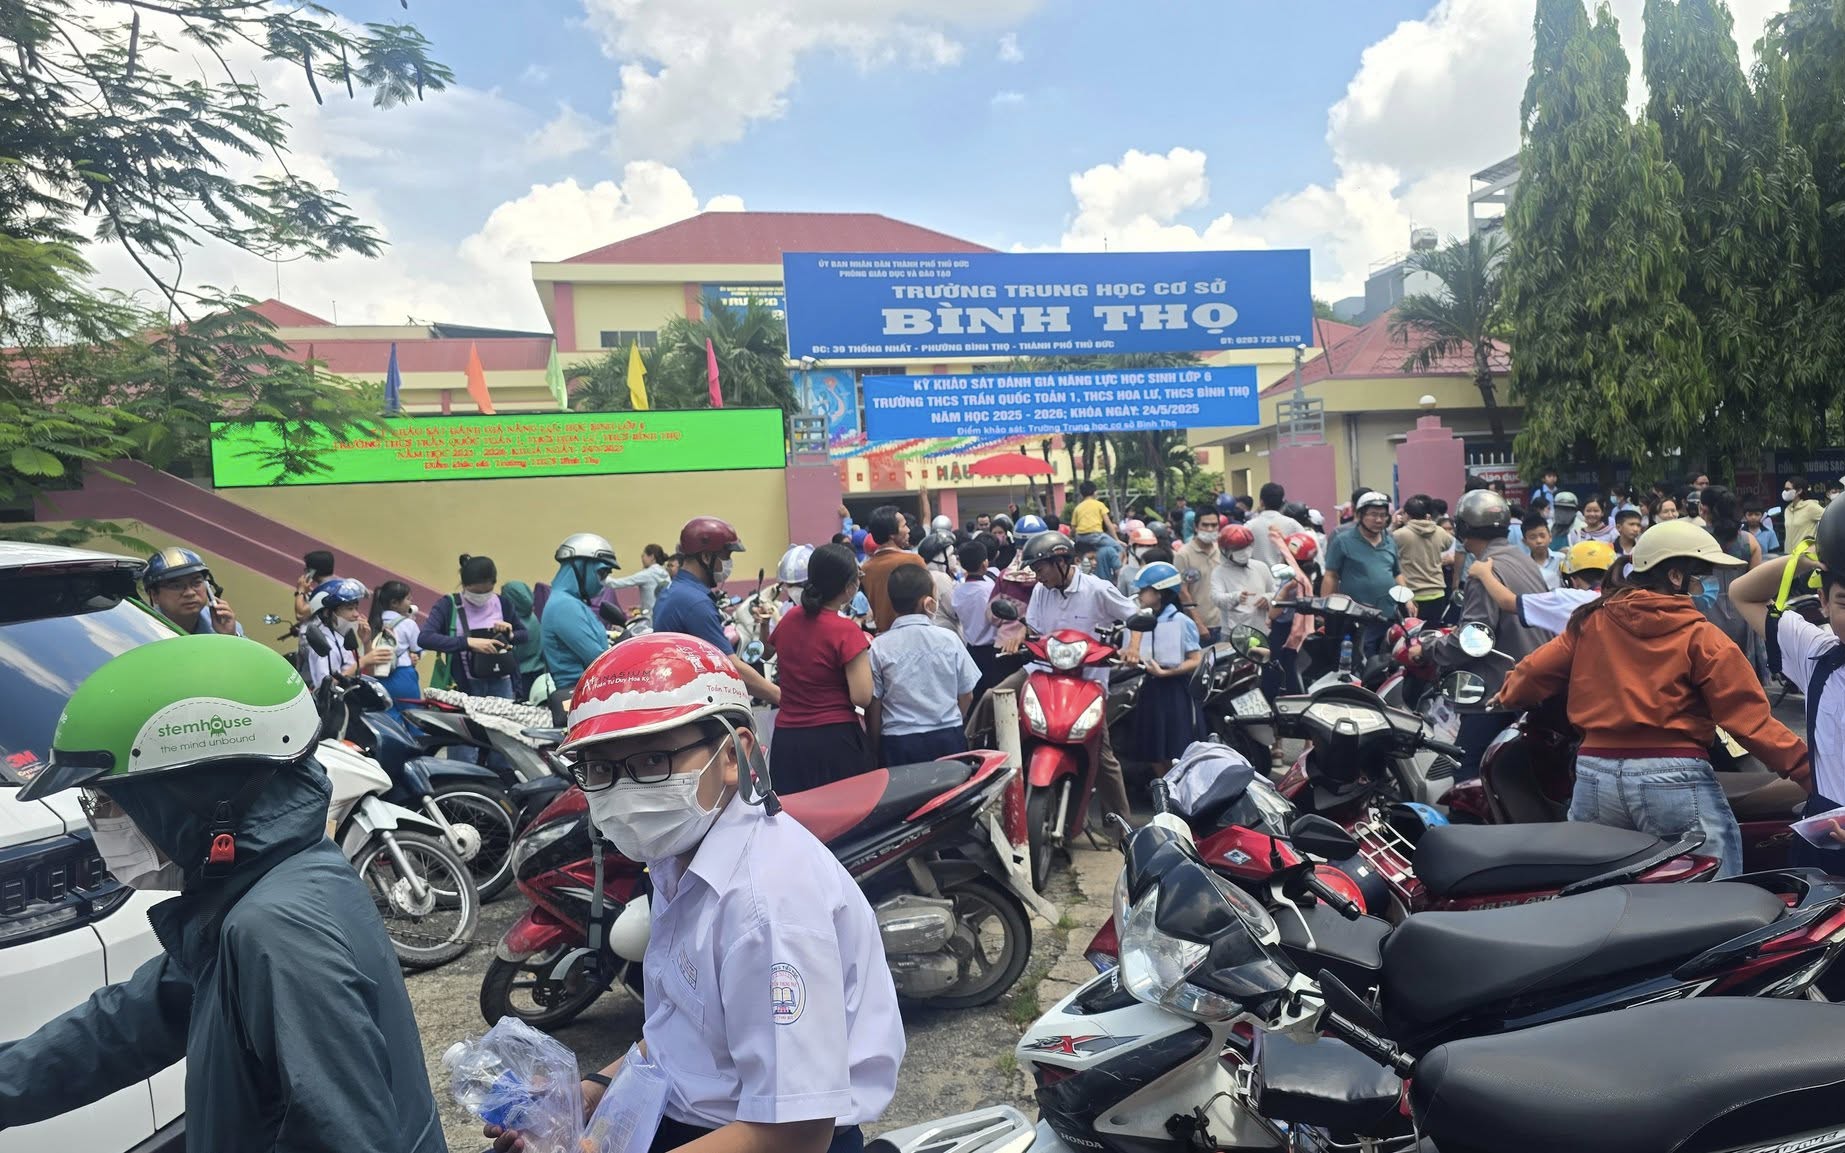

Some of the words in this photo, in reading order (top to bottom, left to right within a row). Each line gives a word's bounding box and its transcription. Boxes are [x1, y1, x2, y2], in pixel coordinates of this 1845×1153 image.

[831, 260, 848, 268] BAN
[891, 283, 997, 299] TRƯỜNG
[1004, 284, 1088, 298] TRUNG
[1096, 283, 1146, 298] HỌC
[1154, 281, 1187, 296] CƠ
[1194, 278, 1227, 294] SỞ
[881, 302, 1071, 335] BÌNH
[1093, 302, 1238, 334] THỌ
[848, 343, 883, 353] THỐNG
[884, 343, 912, 352] NHẤT
[921, 343, 963, 352] PHƯỜNG
[964, 342, 989, 351] BÌNH
[991, 343, 1010, 352] THỌ
[1018, 341, 1051, 350] THÀNH
[1053, 340, 1072, 349] PHỐ
[913, 378, 929, 391] KỲ
[933, 376, 967, 390] KHẢO
[971, 376, 994, 389] SÁT
[998, 375, 1031, 388] ĐÁNH
[1034, 374, 1056, 387] GIÁ
[1058, 373, 1092, 386] NĂNG
[1095, 374, 1118, 386] LỰC
[1121, 373, 1145, 386] HỌC
[1148, 372, 1177, 384] SINH
[1179, 370, 1201, 383] LỚP
[1204, 373, 1212, 382] 6
[872, 395, 924, 409] TRƯỜNG
[927, 395, 959, 407] THCS
[962, 392, 995, 406] TRẦN
[998, 391, 1031, 405] QUỐC
[1083, 391, 1114, 402] THCS
[1117, 390, 1141, 400] HOA
[1143, 388, 1161, 400] LƯ,
[1164, 388, 1194, 399] THCS
[1197, 386, 1225, 398] BÌNH
[1228, 386, 1250, 398] THỌ
[931, 411, 961, 423] NĂM
[964, 411, 990, 424] HỌC
[993, 410, 1022, 421] 2025
[1034, 408, 1067, 420] 2026;
[1070, 406, 1103, 418] KHÓA
[1106, 404, 1139, 417] NGÀY:
[1142, 403, 1199, 415] 24/5/2025
[1063, 422, 1090, 433] Trung
[1137, 419, 1157, 428] Bình
[1159, 419, 1177, 429] Thọ
[158, 715, 252, 738] stemhouse
[160, 745, 178, 754] the
[180, 740, 206, 751] mind
[208, 733, 256, 747] unbound
[5, 750, 40, 769] 3M
[1060, 1132, 1104, 1150] HONDA
